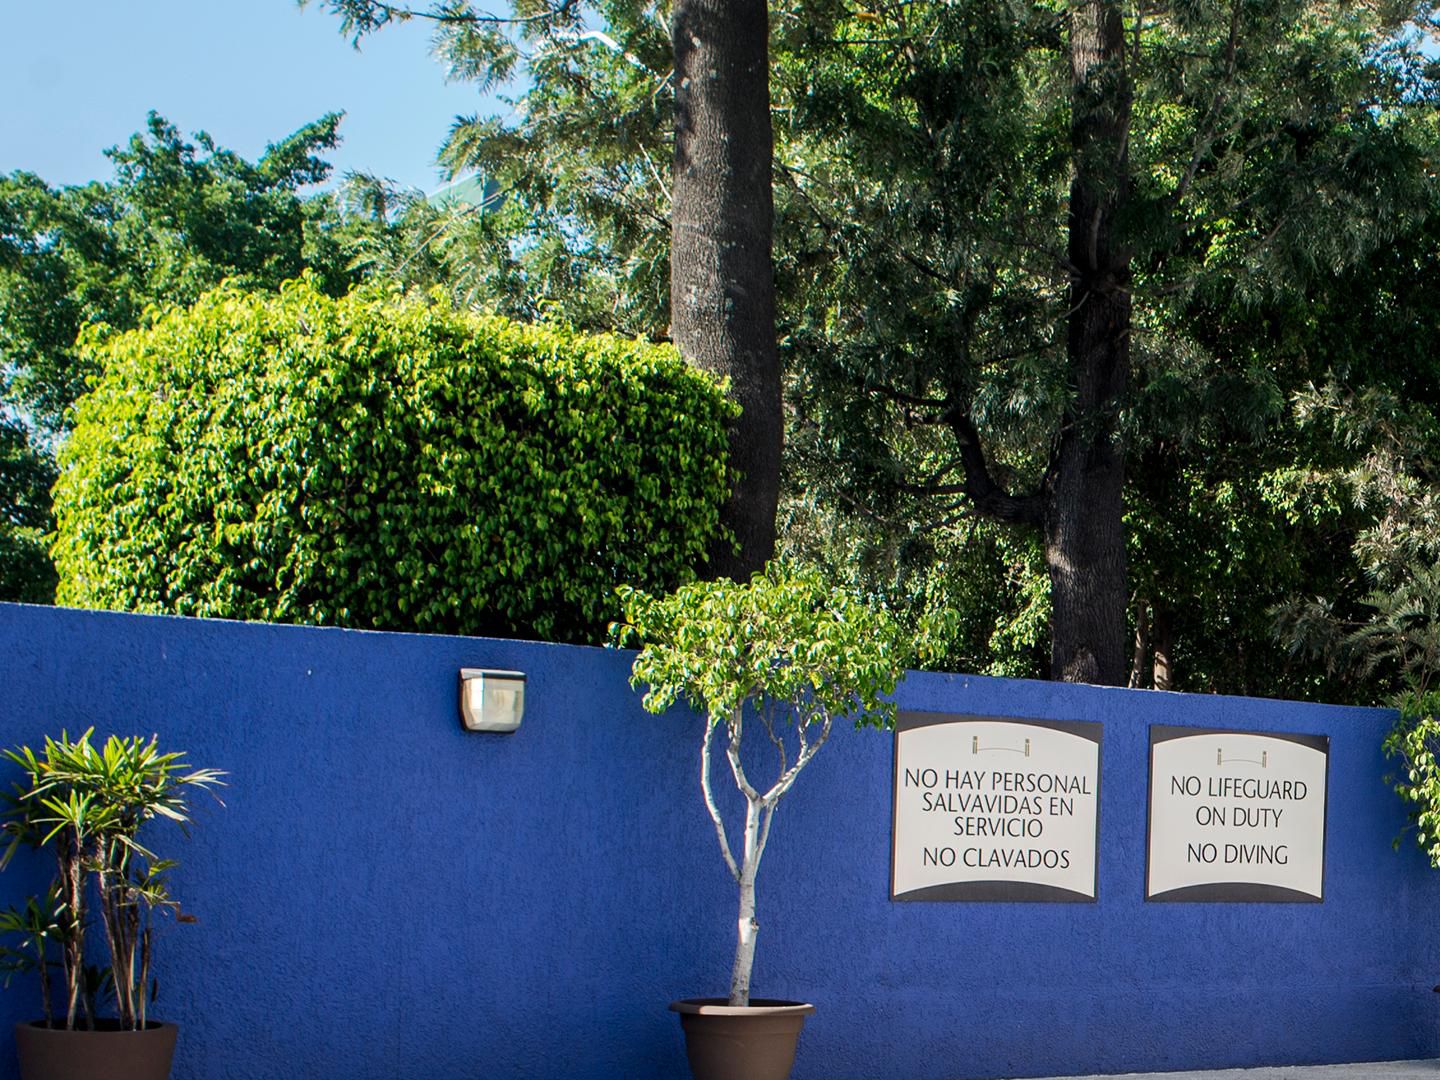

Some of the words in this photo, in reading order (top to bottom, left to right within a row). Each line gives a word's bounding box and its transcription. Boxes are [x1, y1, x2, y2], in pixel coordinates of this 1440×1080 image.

[906, 768, 938, 788] NO
[945, 770, 986, 790] HAY
[992, 772, 1091, 796] PERSONAL
[1171, 775, 1202, 796] NO
[1208, 777, 1308, 801] LIFEGUARD
[922, 791, 1042, 816] SALVAVIDAS
[1049, 796, 1074, 816] EN
[953, 816, 1043, 838] SERVICIO
[1195, 805, 1226, 826] ON
[1233, 807, 1283, 828] DUTY
[923, 847, 956, 867] NO
[963, 847, 1070, 869] CLAVADOS
[1187, 843, 1218, 863] NO
[1224, 843, 1288, 865] DIVING
